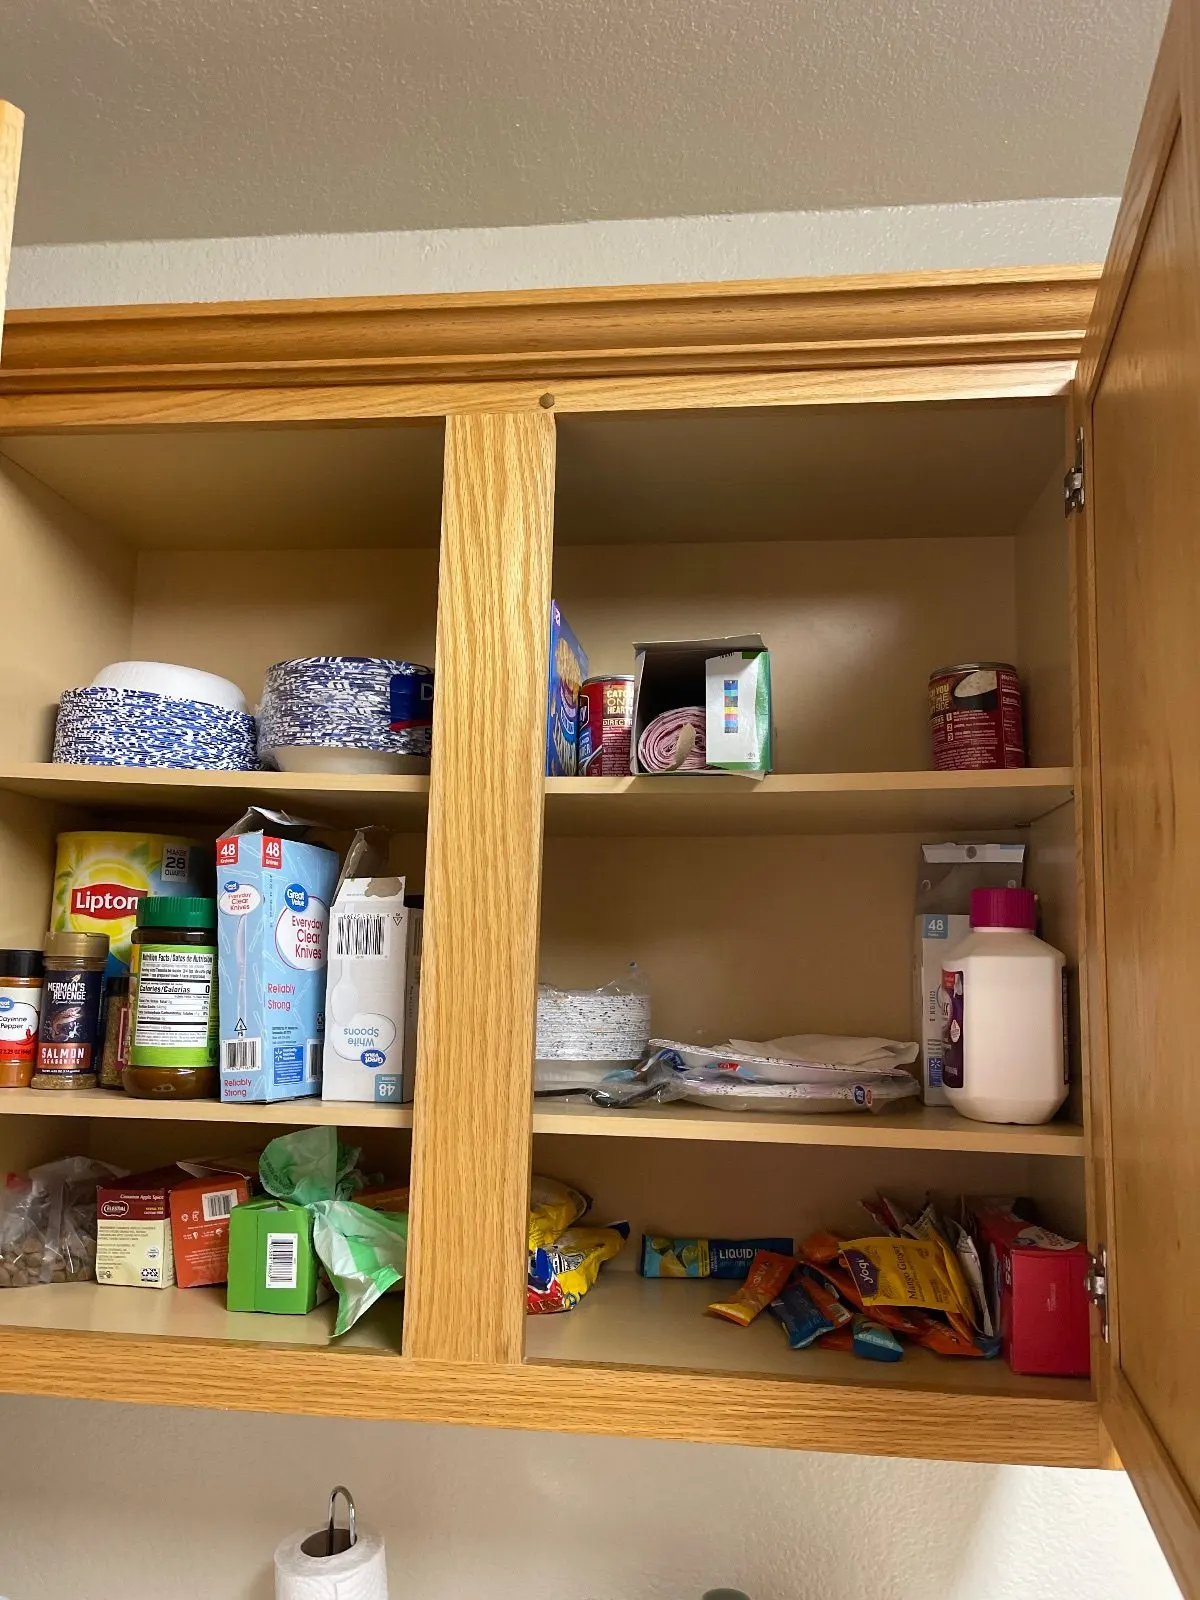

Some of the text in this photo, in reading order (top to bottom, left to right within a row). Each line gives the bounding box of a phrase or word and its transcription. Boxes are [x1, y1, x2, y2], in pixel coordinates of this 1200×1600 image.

[220, 844, 236, 856] 48
[266, 842, 280, 858] 48
[166, 857, 186, 870] 28
[287, 889, 304, 900] Great
[76, 890, 139, 912] Lipton
[292, 916, 324, 930] Everyday
[928, 919, 944, 931] 48
[296, 928, 321, 944] Clear
[296, 944, 322, 960] Knives
[48, 982, 86, 992] MERMAN'S
[205, 984, 210, 994] 0
[267, 983, 296, 994] Reliably
[53, 990, 86, 1000] REVENGE
[267, 999, 291, 1012] Strong
[344, 1026, 380, 1038] Spoons
[348, 1038, 375, 1047] White
[41, 1048, 84, 1059] SALMON
[364, 1056, 384, 1064] Great
[224, 1078, 252, 1087] Reliably
[224, 1088, 247, 1098] Strong
[378, 1084, 396, 1096] 48
[720, 1248, 753, 1259] LIQUID
